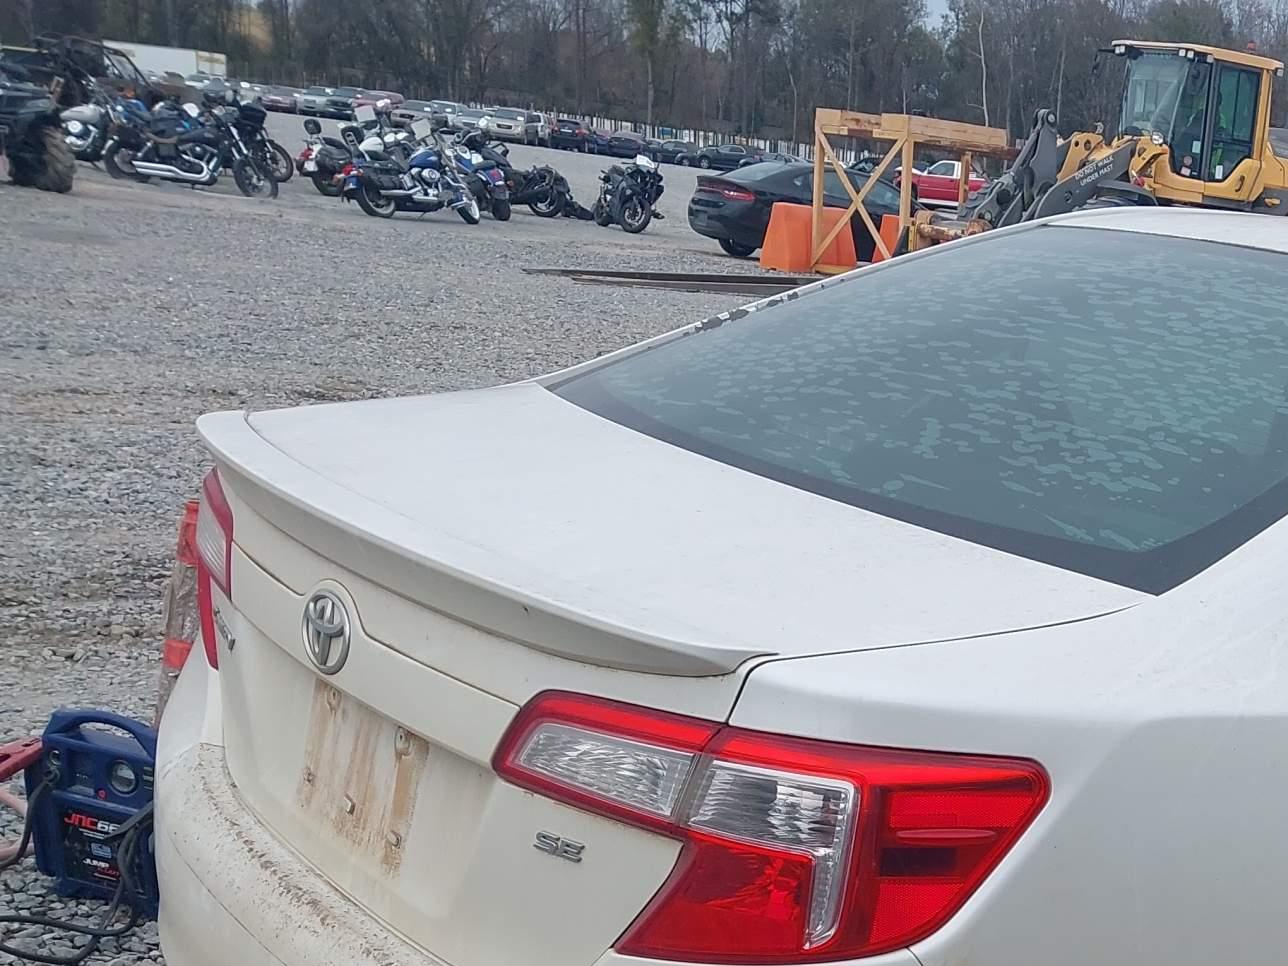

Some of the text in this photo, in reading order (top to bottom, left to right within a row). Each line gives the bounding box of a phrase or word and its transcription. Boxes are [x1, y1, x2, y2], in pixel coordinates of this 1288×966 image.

[1080, 164, 1113, 186] UNDER MAST
[1085, 163, 1097, 174] NOT
[1097, 155, 1114, 166] WALK
[533, 830, 586, 863] SE
